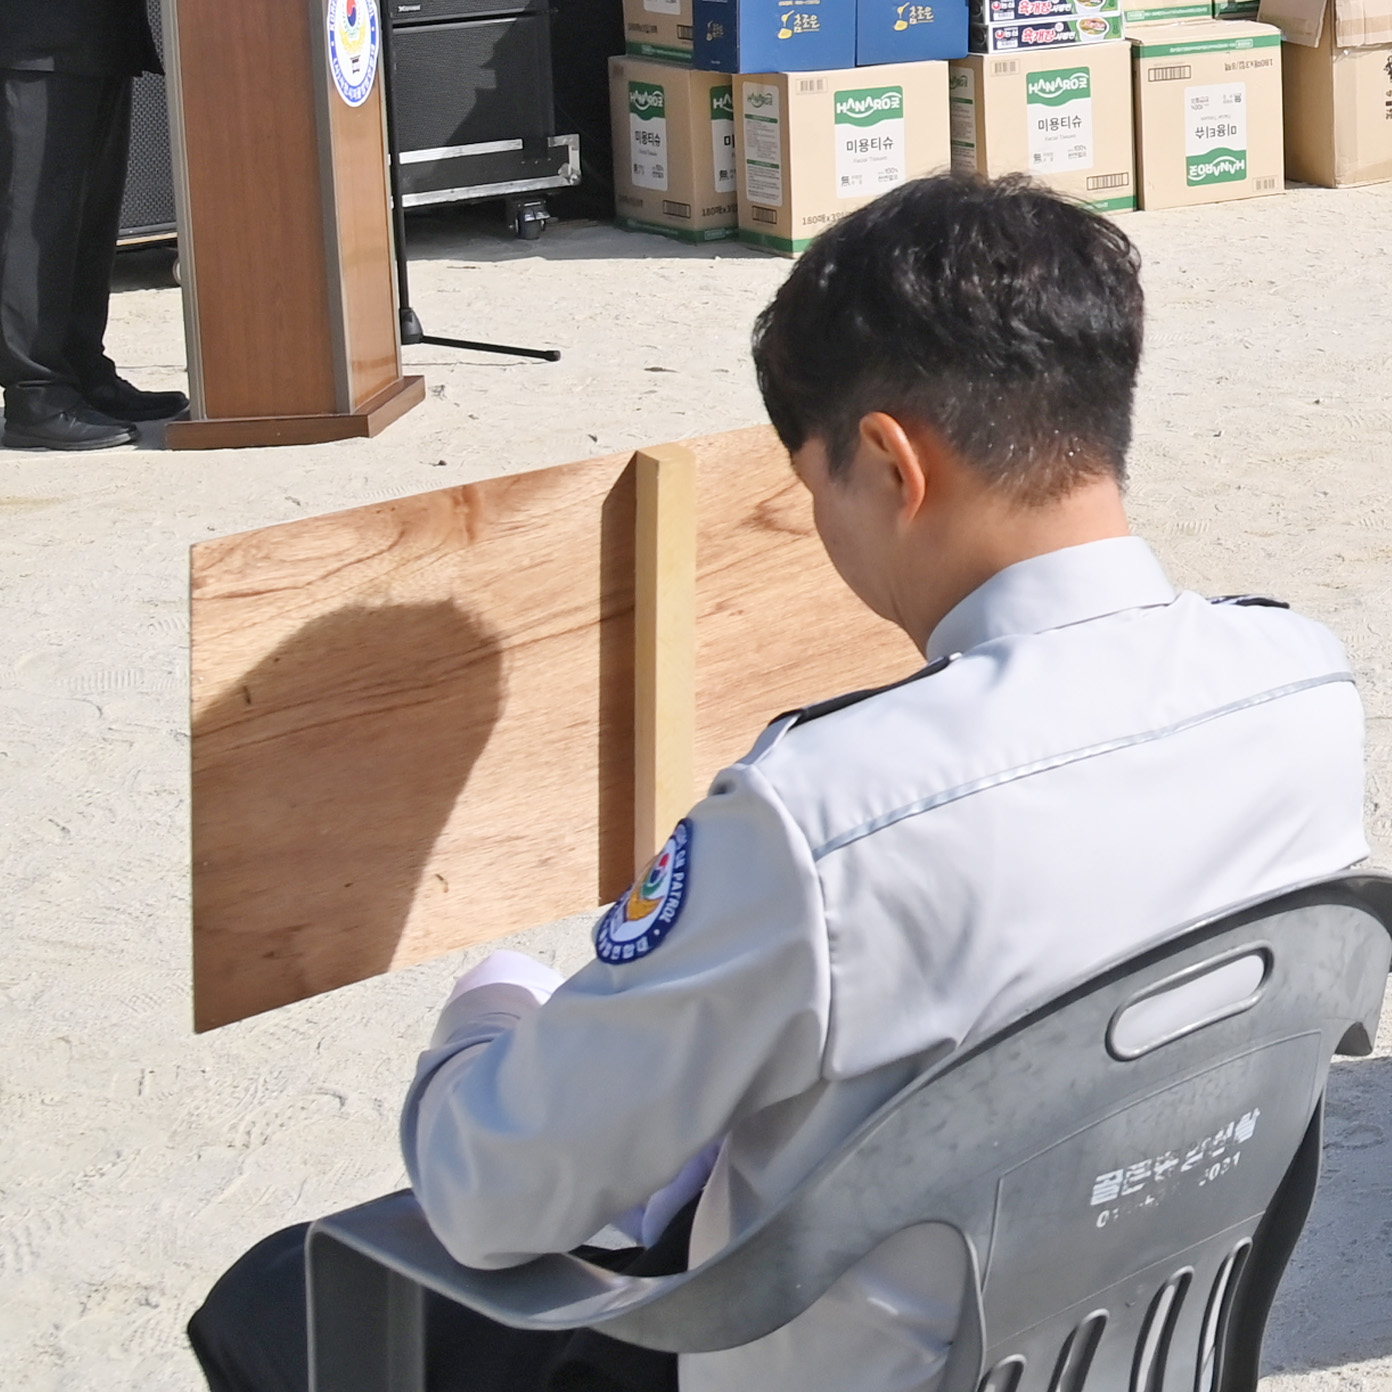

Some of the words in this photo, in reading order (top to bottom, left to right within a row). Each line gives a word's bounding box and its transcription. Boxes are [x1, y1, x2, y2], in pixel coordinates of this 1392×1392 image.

[1018, 0, 1052, 16] 육개장
[1022, 27, 1057, 44] 육개장
[1038, 115, 1083, 132] 미용티슈
[1195, 123, 1238, 140] 미용티슈
[846, 136, 894, 153] 미용티슈
[660, 871, 685, 924] PATROL
